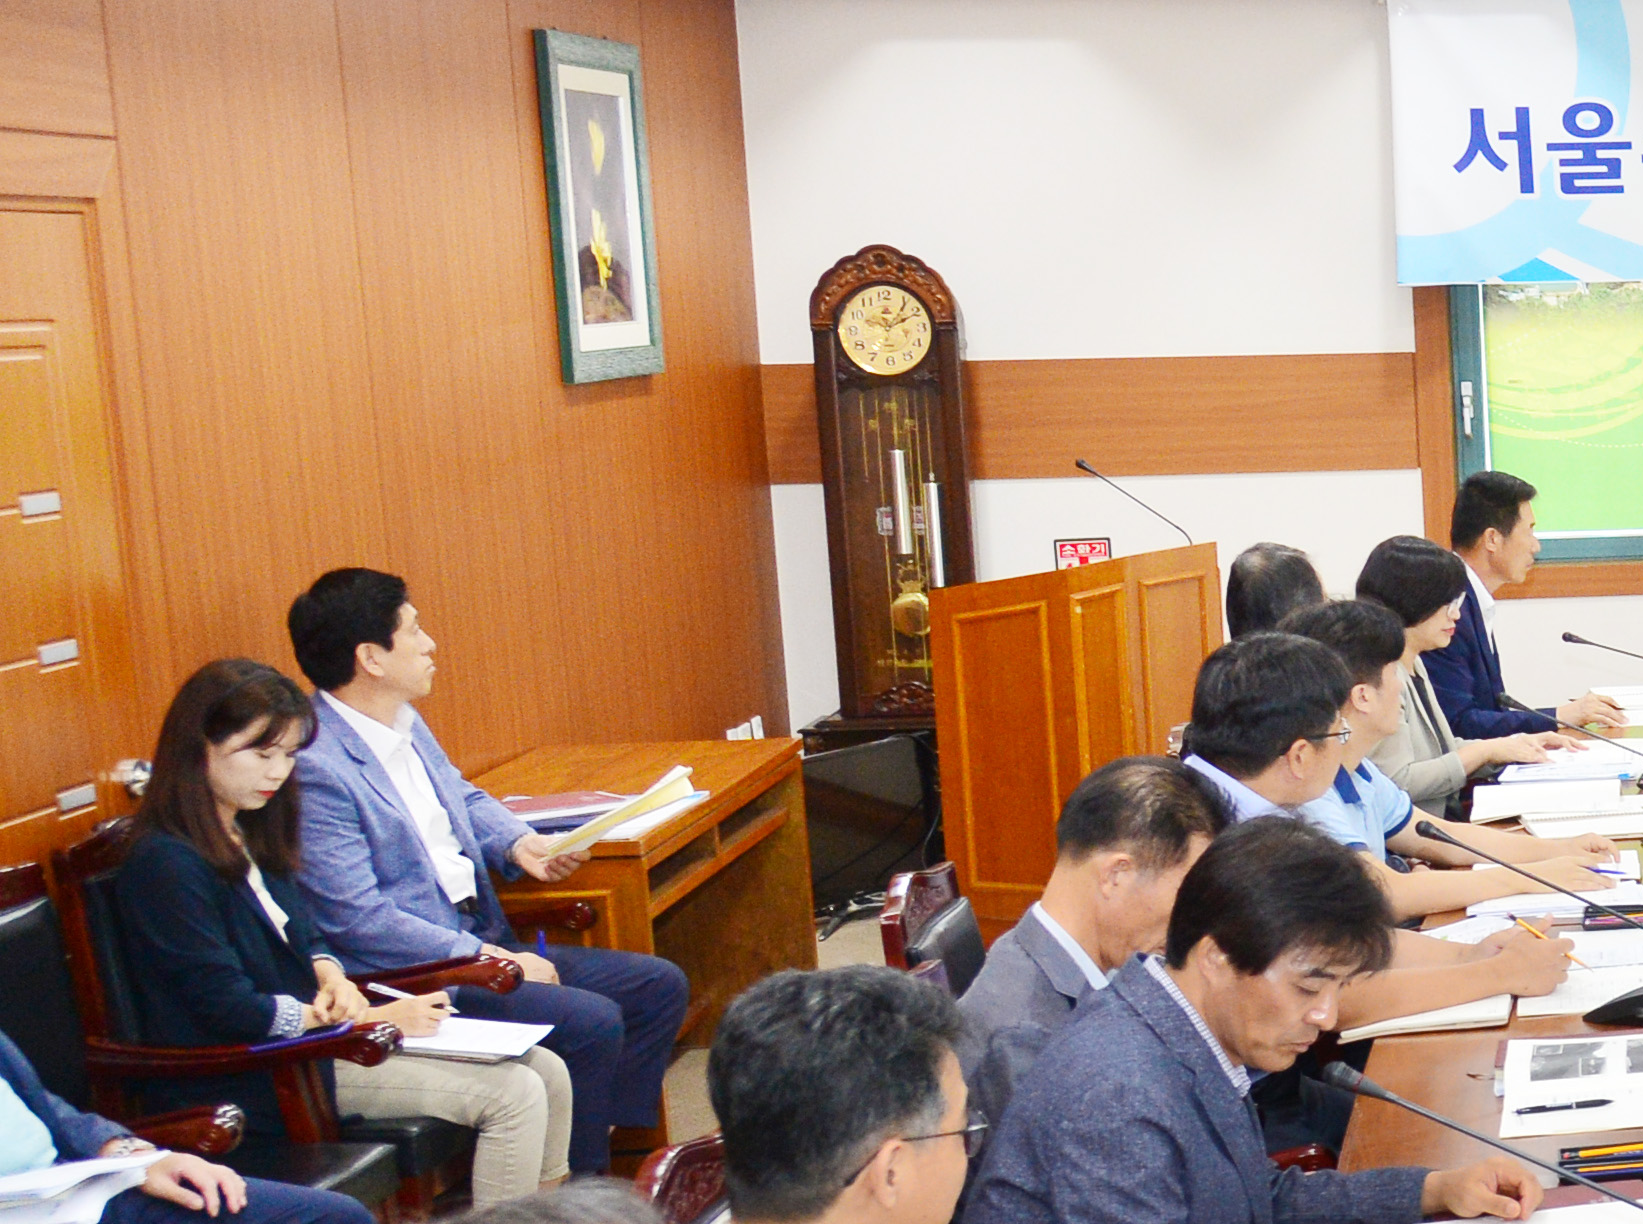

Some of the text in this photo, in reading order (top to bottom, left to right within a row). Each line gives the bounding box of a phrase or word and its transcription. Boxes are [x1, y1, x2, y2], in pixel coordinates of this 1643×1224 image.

[877, 290, 891, 300] 12
[861, 297, 873, 307] 11
[851, 310, 864, 320] 10
[917, 322, 927, 332] 3
[854, 341, 865, 350] 8
[912, 338, 922, 347] 4
[868, 352, 877, 361] 7
[886, 356, 896, 366] 6
[1061, 543, 1106, 556] 소화기
